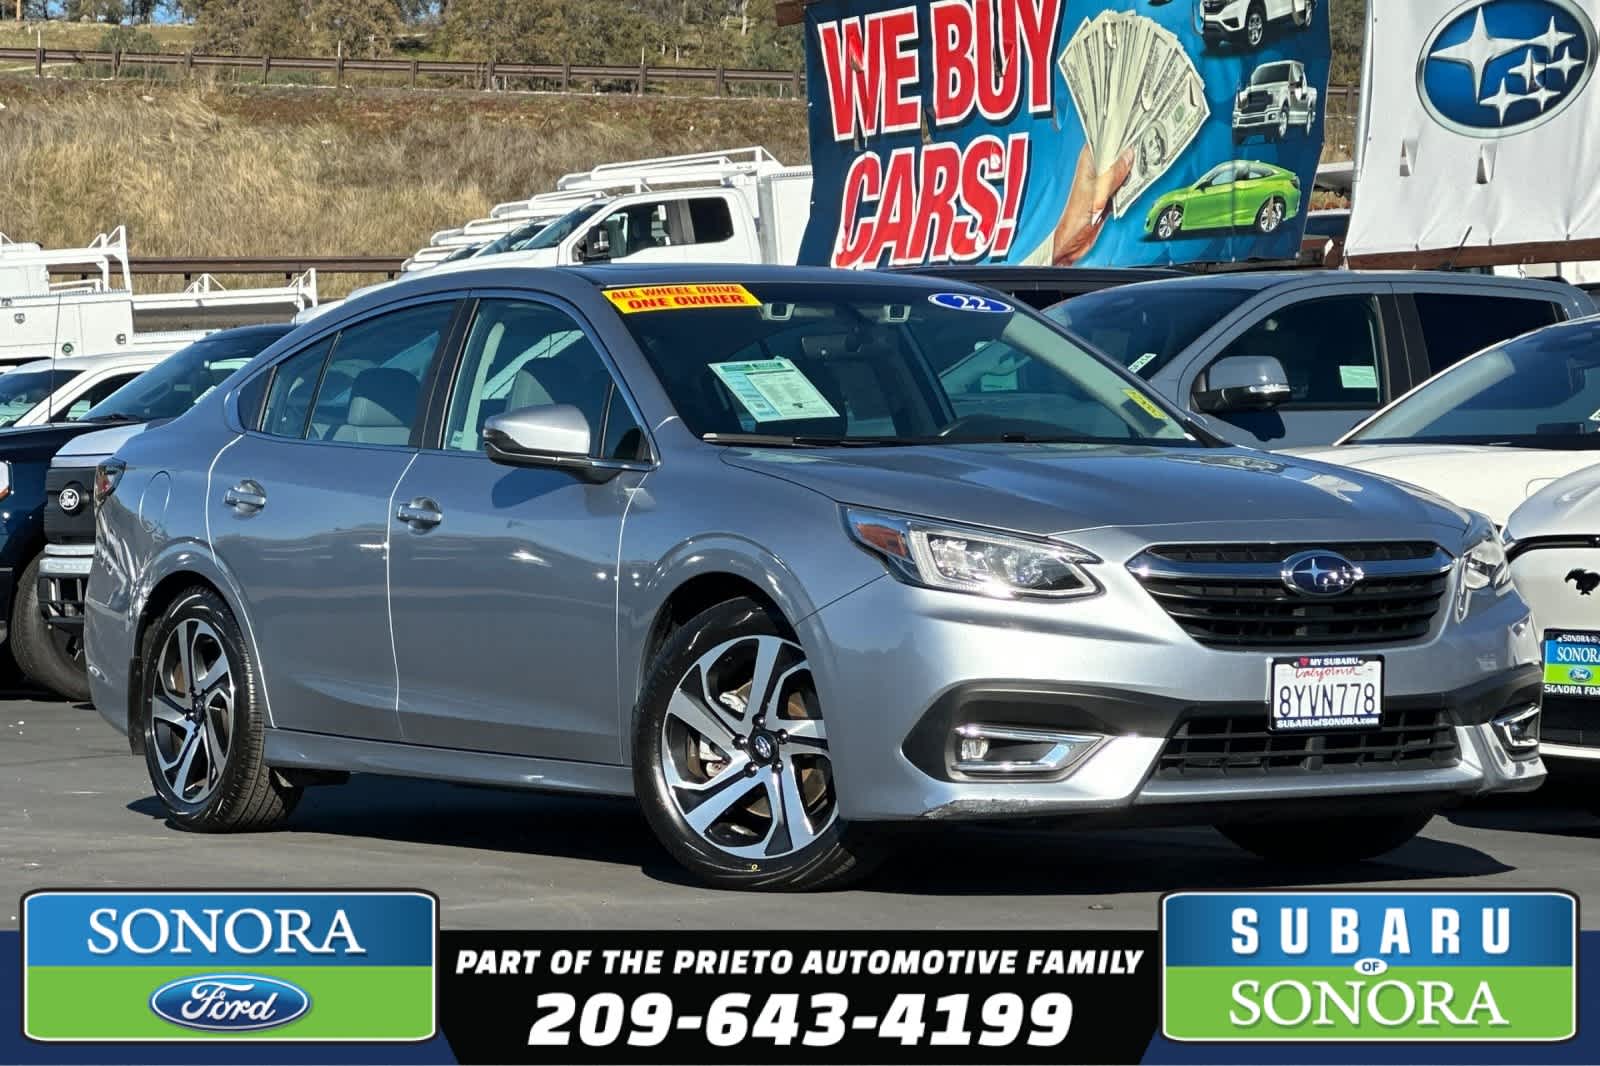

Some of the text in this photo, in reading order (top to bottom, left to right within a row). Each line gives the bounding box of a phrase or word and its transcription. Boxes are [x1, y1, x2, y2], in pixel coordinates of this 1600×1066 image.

[817, 0, 1062, 142] WE BUY
[830, 132, 1029, 270] CARS!
[611, 284, 740, 300] ALL WHEEL DRIVE
[627, 294, 744, 309] ONE OWNER
[953, 295, 990, 309] 22
[1310, 657, 1359, 666] MY SUBARU
[1295, 667, 1364, 682] California
[1544, 684, 1582, 695] SONORA
[1279, 683, 1375, 718] 8YVN778
